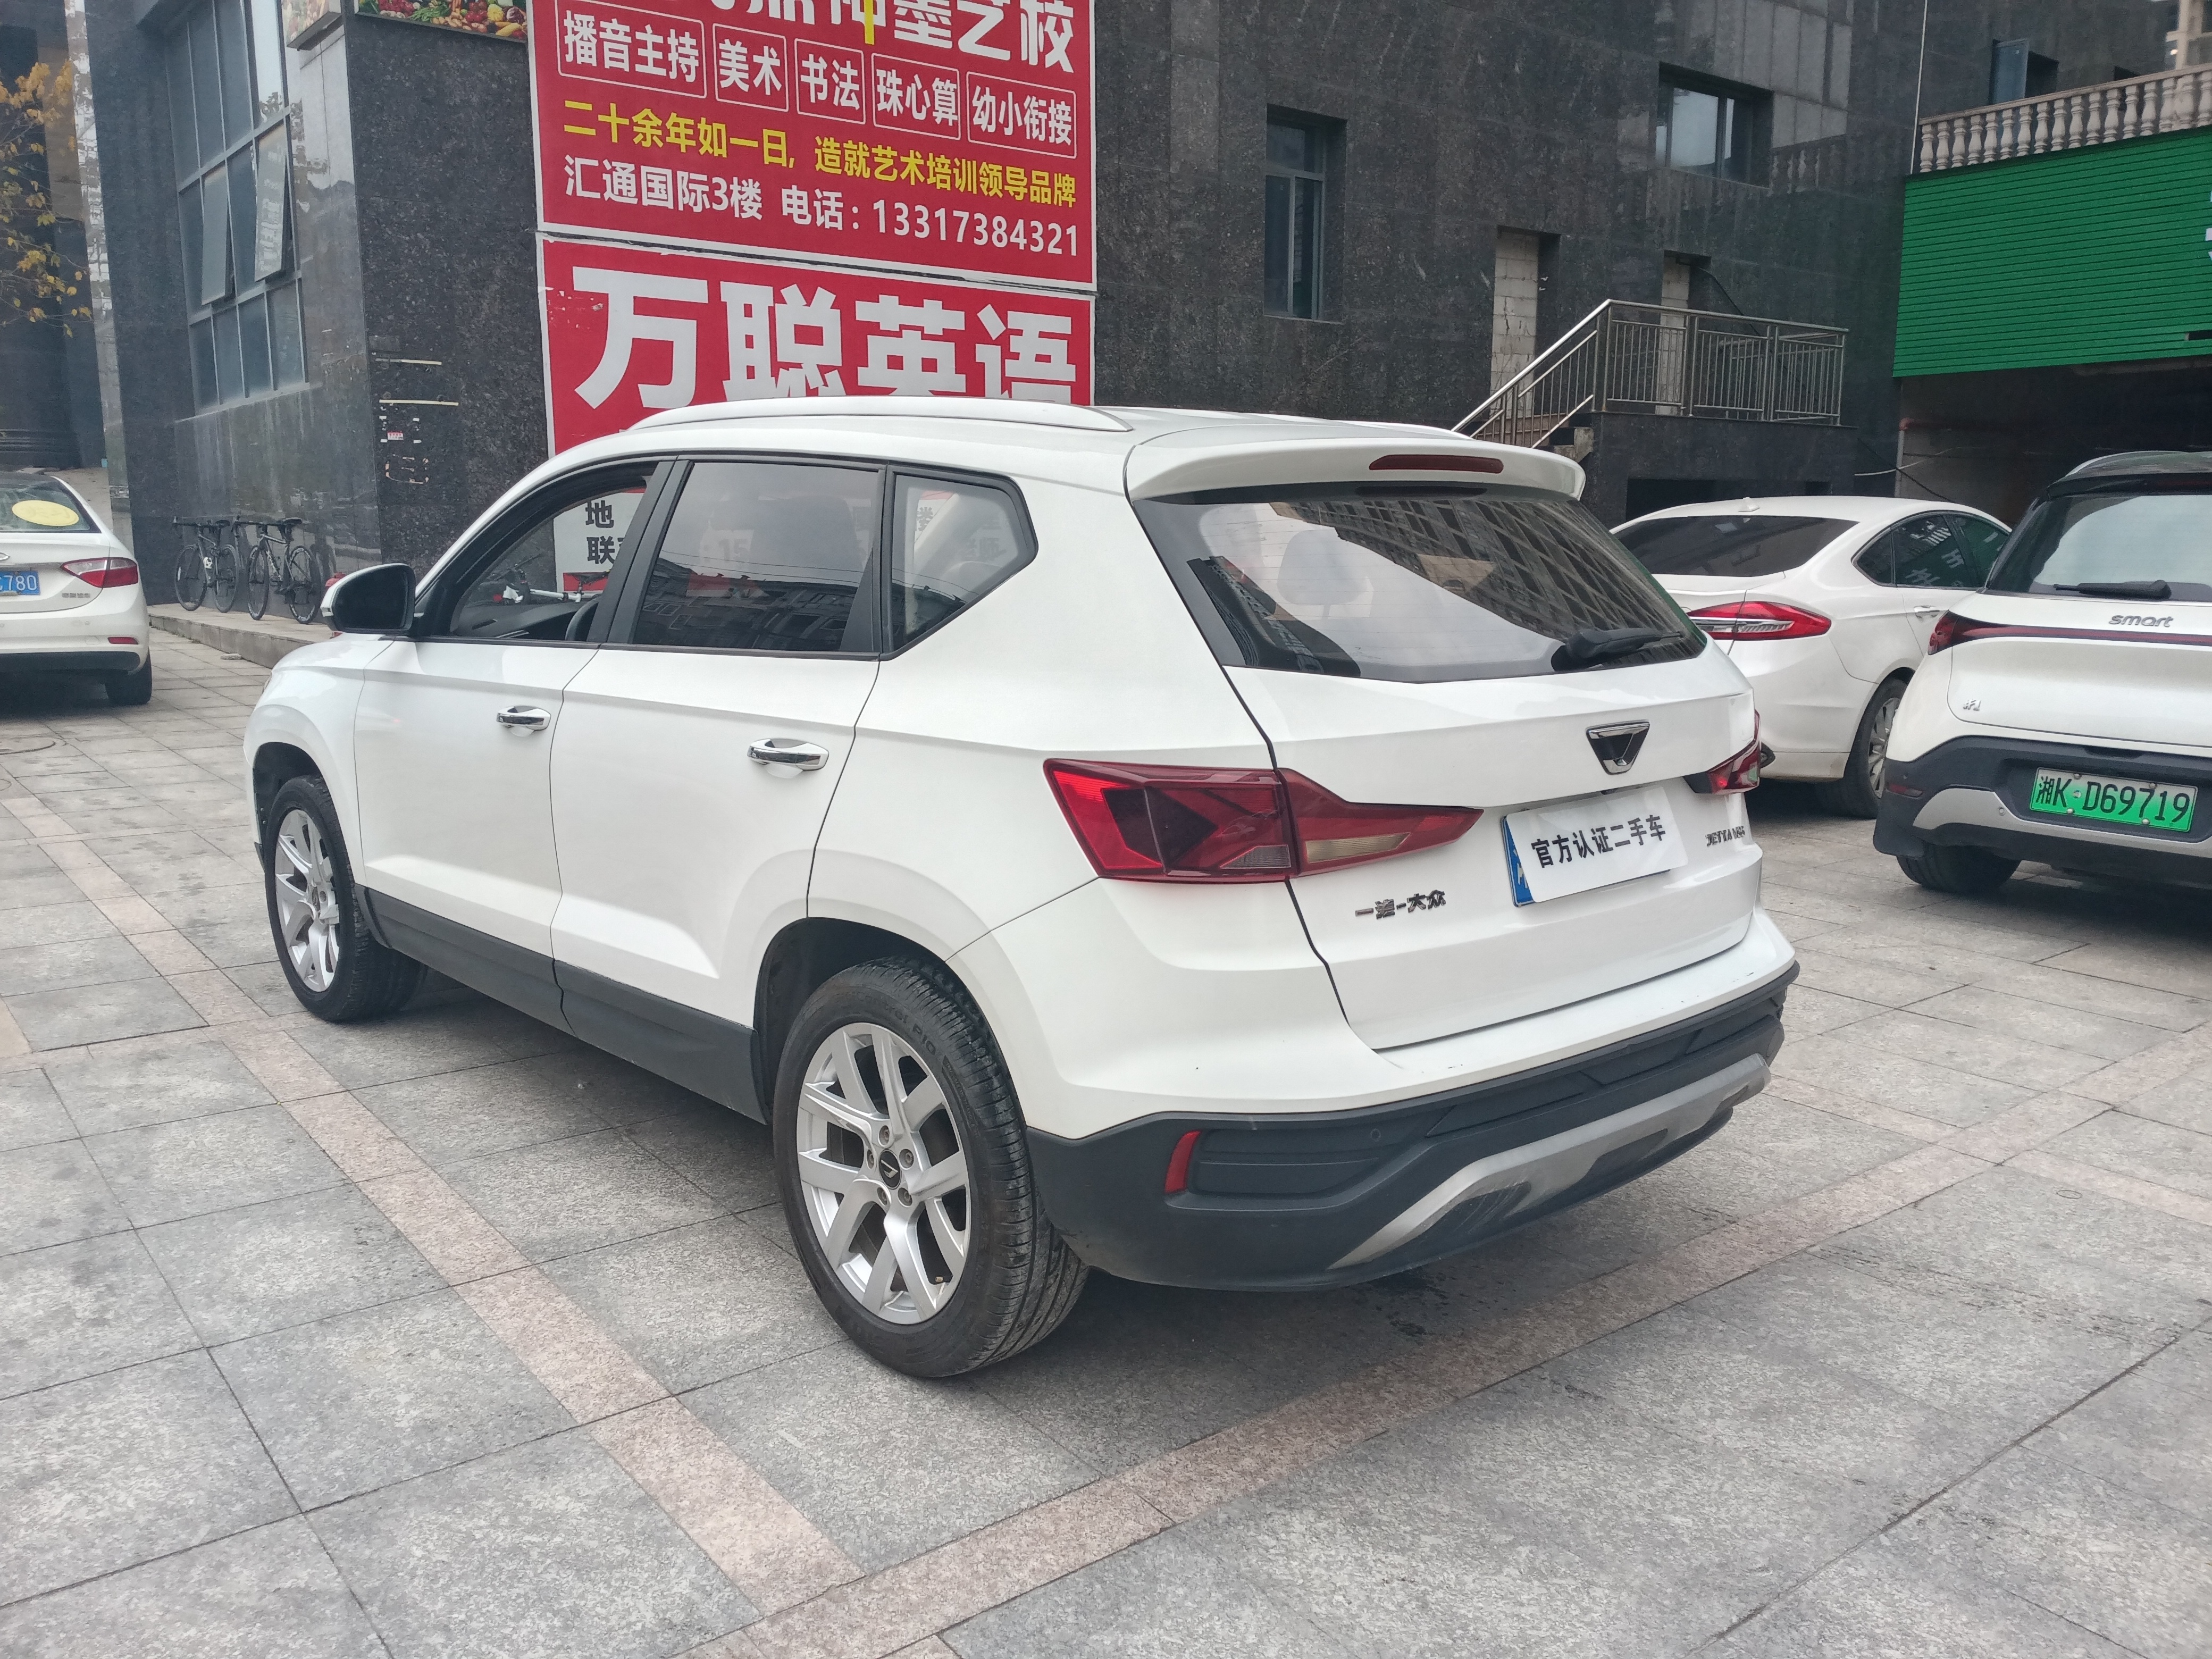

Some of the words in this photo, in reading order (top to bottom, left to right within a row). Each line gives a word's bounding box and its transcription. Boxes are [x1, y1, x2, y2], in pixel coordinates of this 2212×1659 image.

[564, 10, 699, 82] 播音主持
[718, 39, 782, 96] 美术
[800, 54, 860, 110] 书法
[876, 69, 958, 127] 珠心算
[972, 85, 1072, 146] 幼小衔接
[564, 154, 763, 220] 汇通国际3楼
[573, 266, 1077, 409] 万聪英语
[586, 536, 624, 565] 联
[0, 575, 37, 591] 780
[2109, 615, 2174, 627] smart
[1531, 814, 1666, 868] 官方认证二手车
